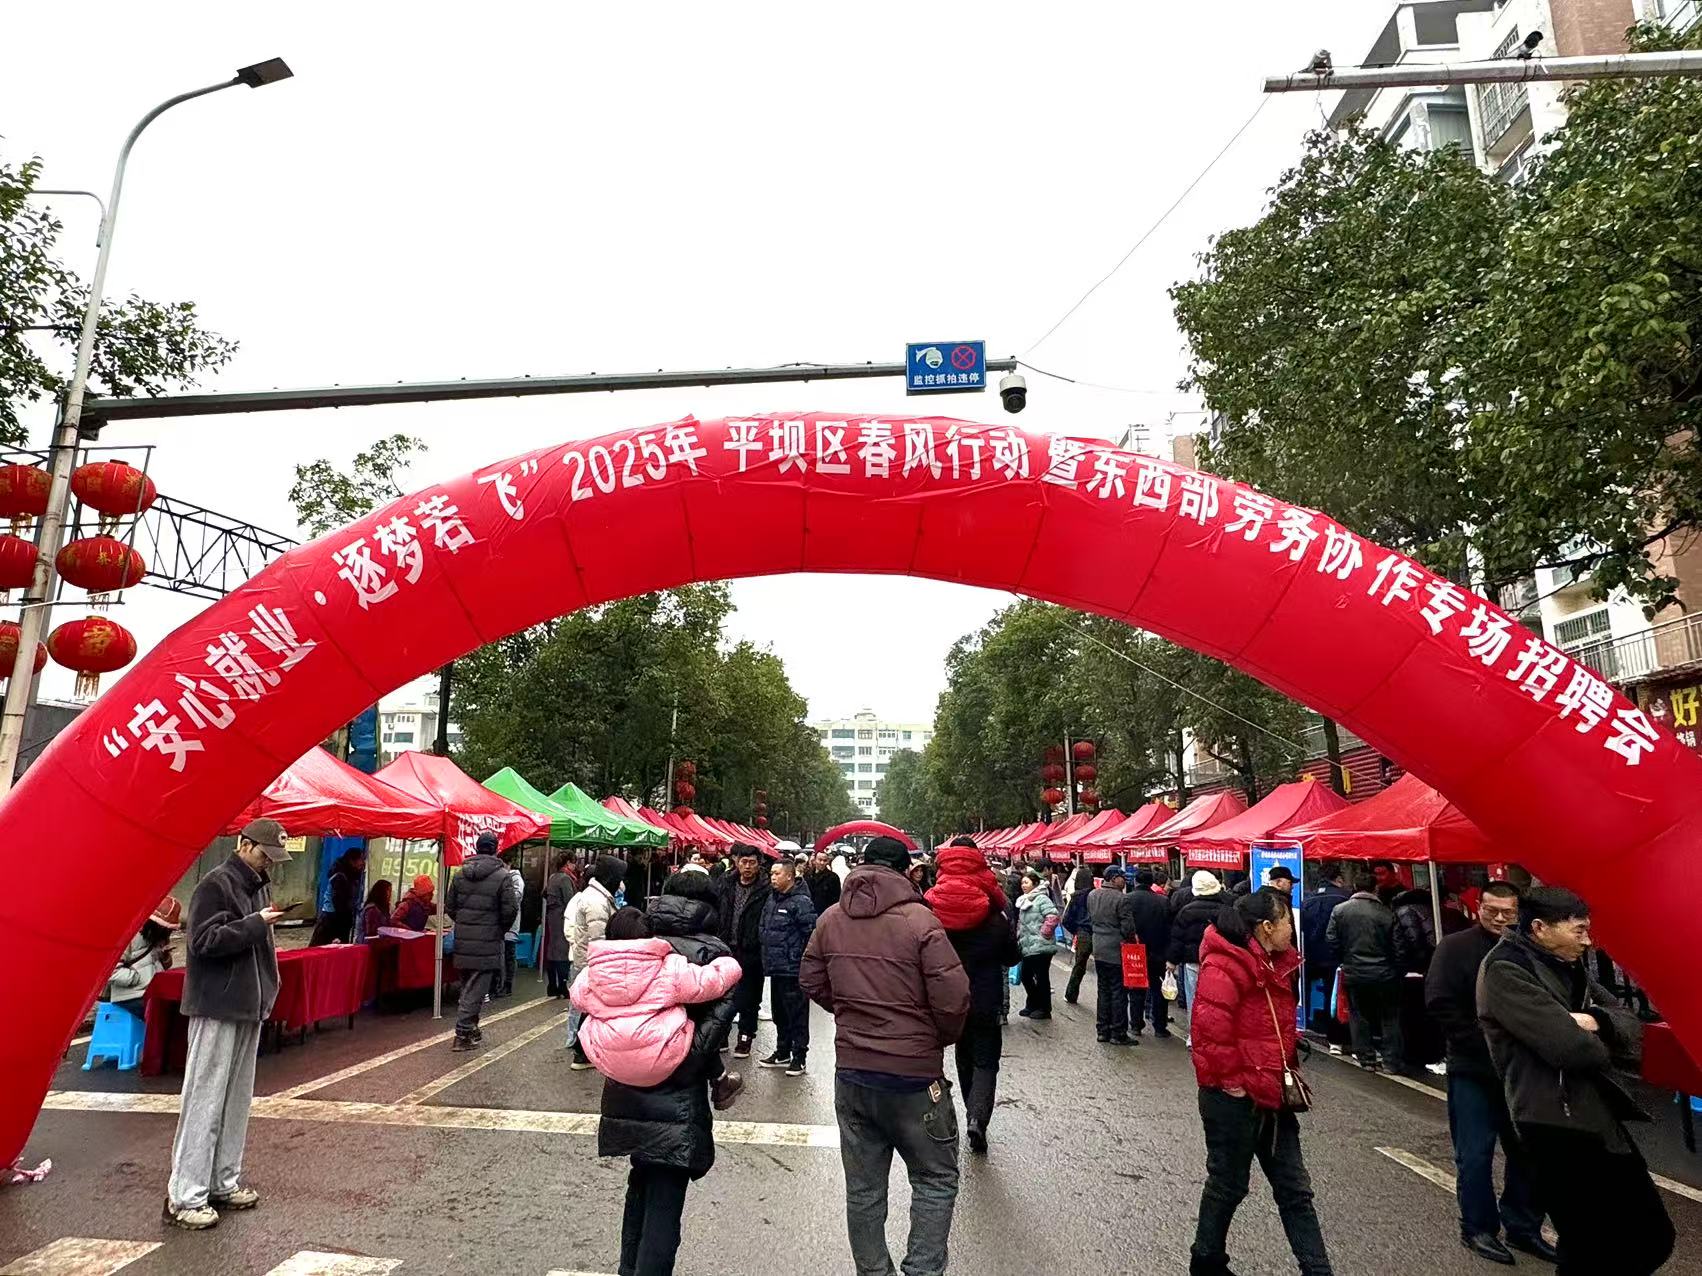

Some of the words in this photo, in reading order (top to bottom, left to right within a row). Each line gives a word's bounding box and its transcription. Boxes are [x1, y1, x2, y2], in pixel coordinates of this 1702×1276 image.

[913, 372, 980, 385] 监控抓拍违停
